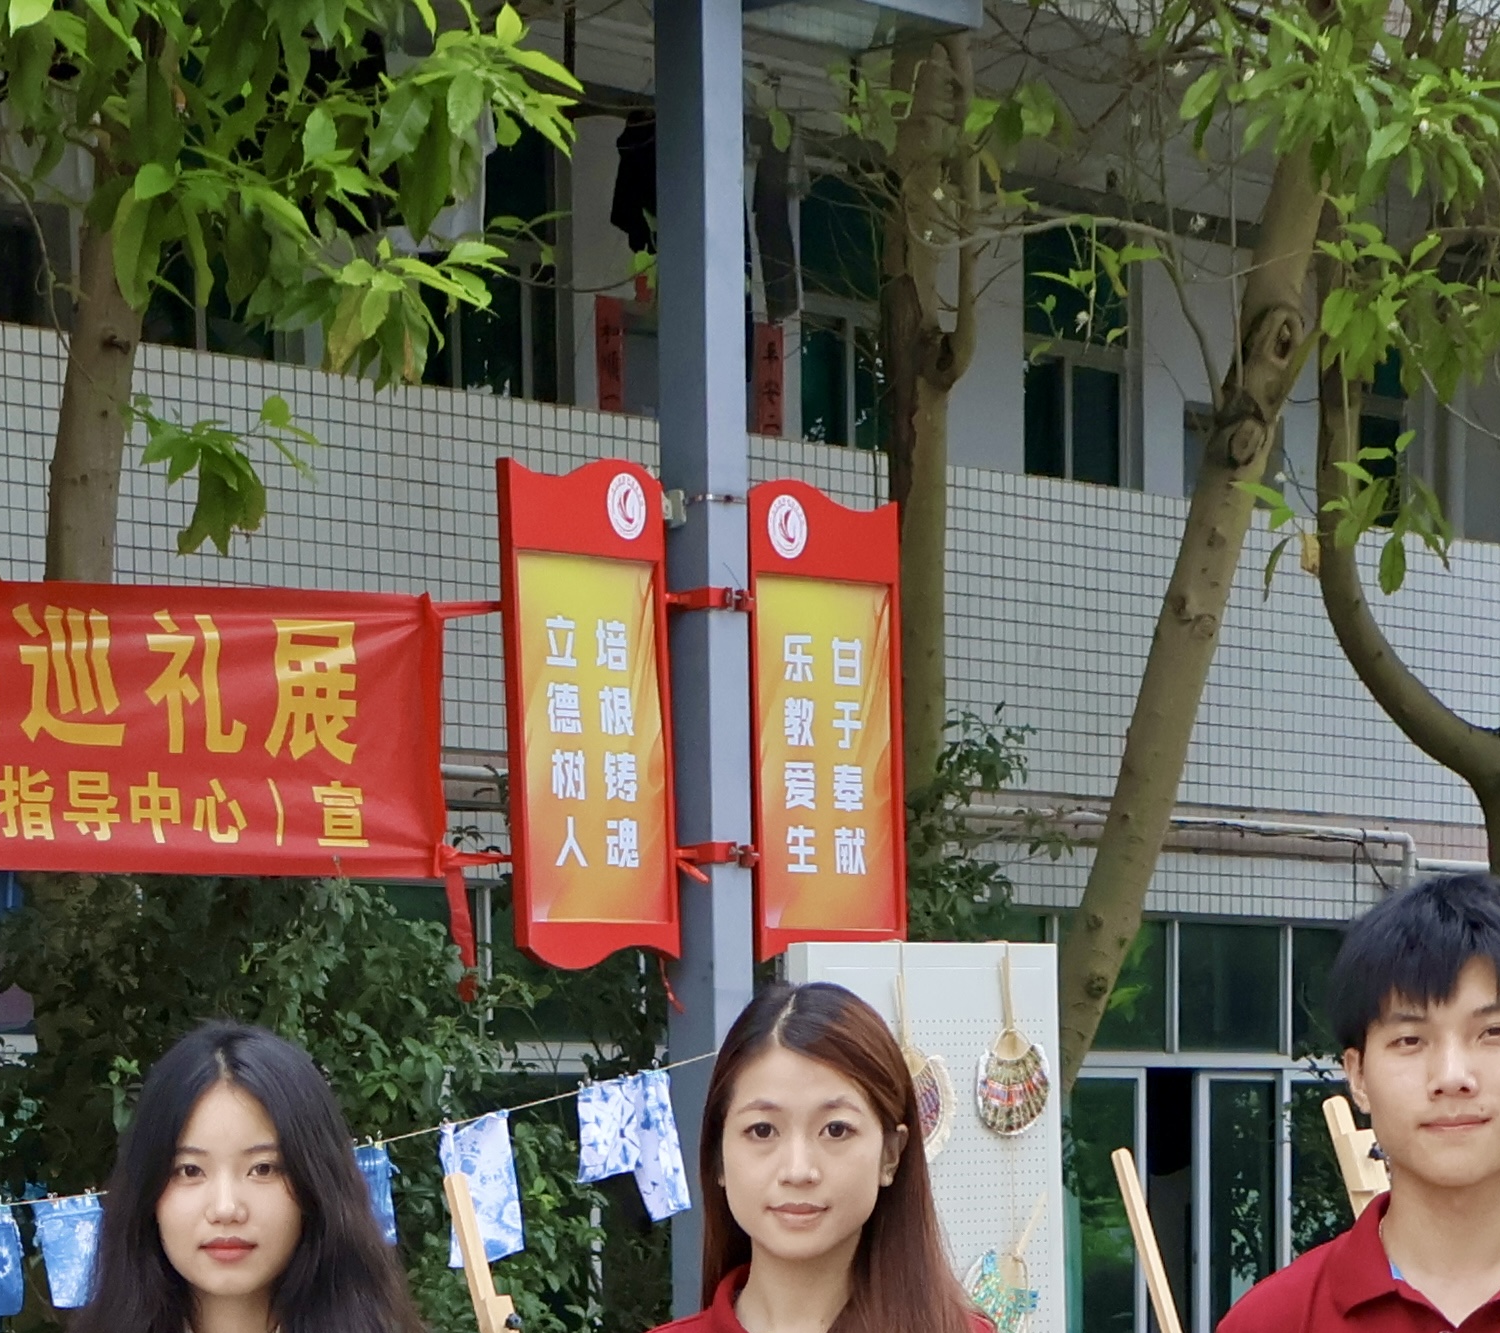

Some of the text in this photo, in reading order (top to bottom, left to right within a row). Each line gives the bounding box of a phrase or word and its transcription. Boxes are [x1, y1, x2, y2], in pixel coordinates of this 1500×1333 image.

[545, 615, 588, 868] 立德树人
[595, 619, 640, 868] 培根铸魂
[782, 634, 818, 874] 乐教爱生
[831, 637, 867, 875] 甘于奉献
